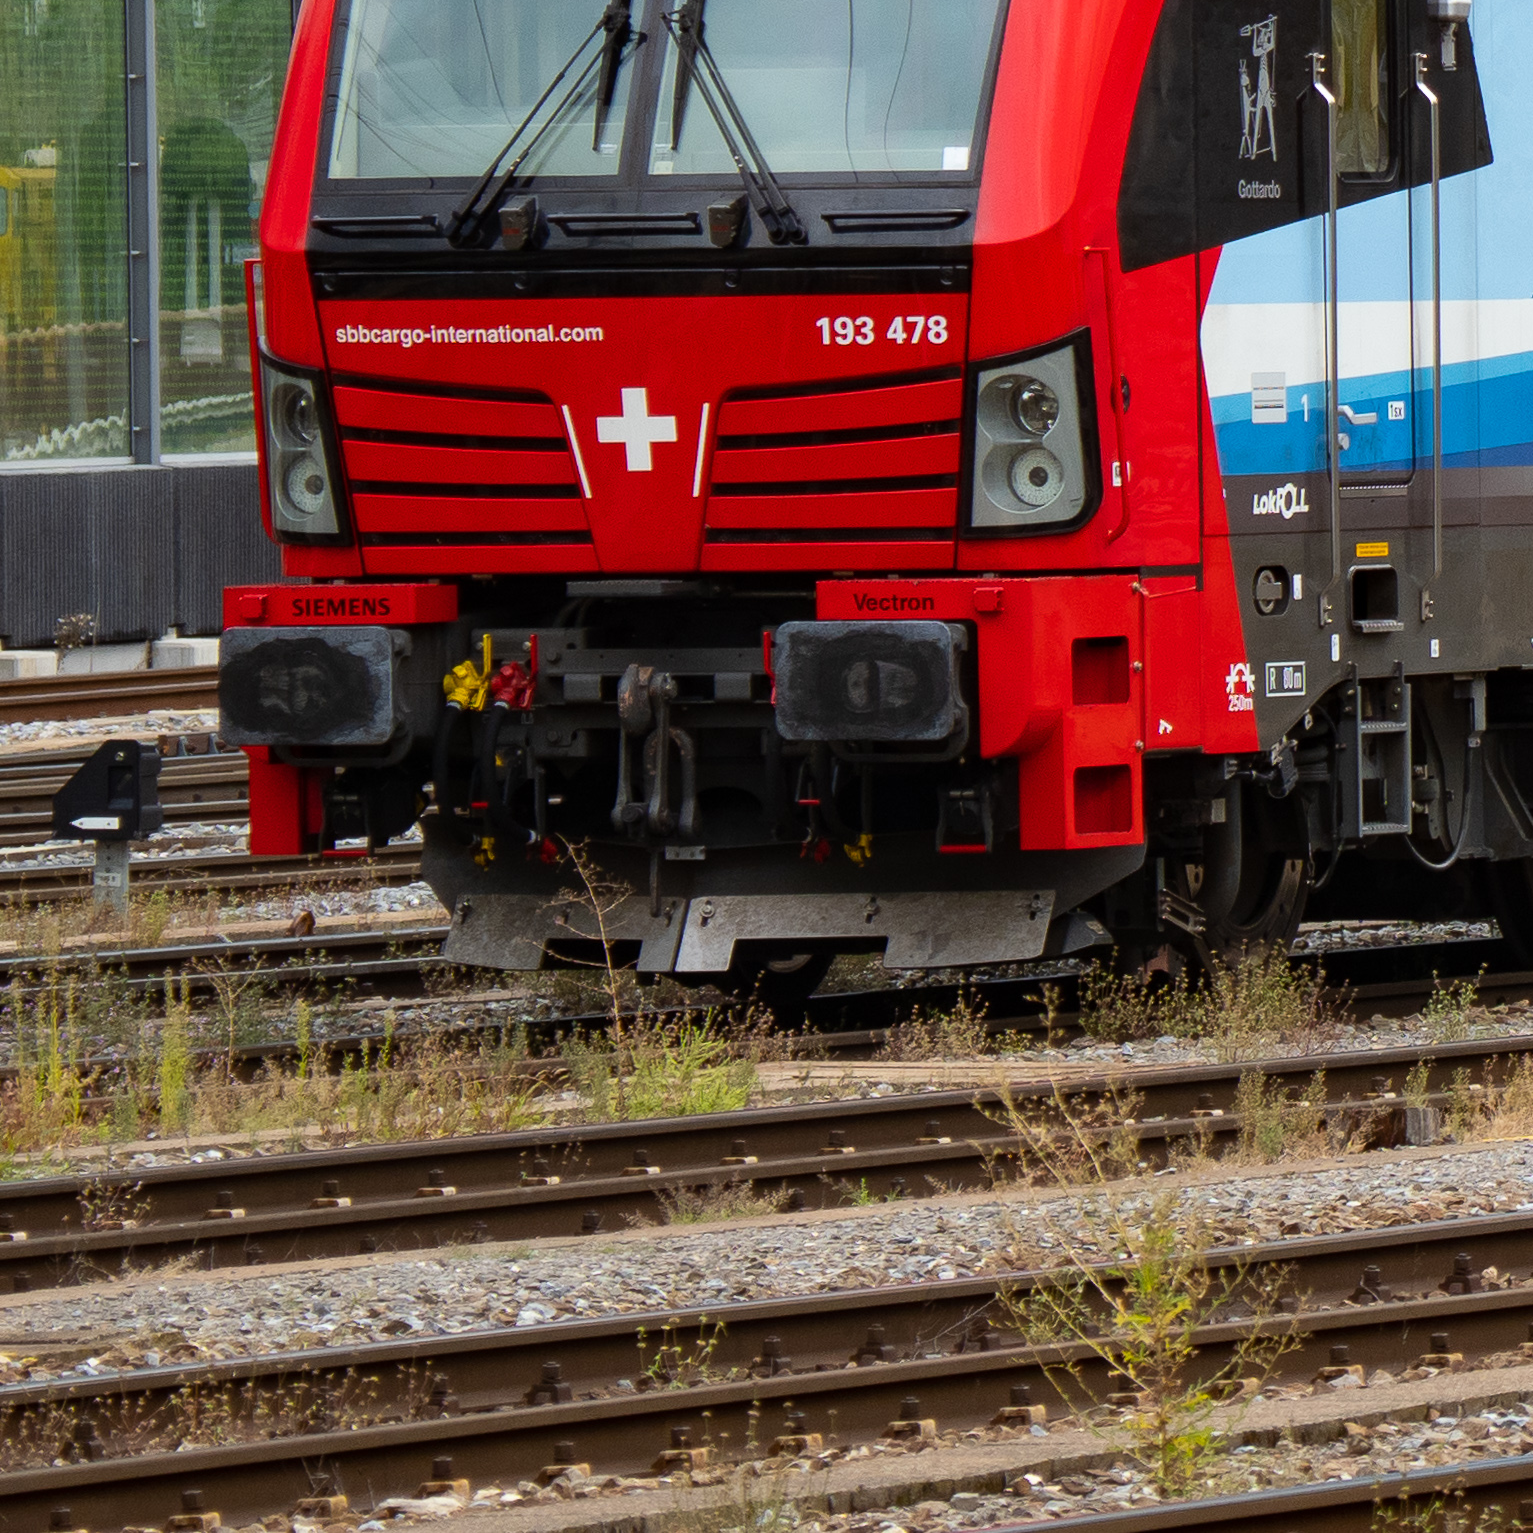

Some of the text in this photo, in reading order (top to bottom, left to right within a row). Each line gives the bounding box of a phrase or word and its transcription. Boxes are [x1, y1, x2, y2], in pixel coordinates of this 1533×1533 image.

[1238, 179, 1281, 198] Gottardo
[336, 324, 603, 348] sbbcargo-international.com
[815, 316, 949, 346] 193 478
[292, 595, 391, 619] SIEMENS
[853, 593, 935, 613] Vectron
[1269, 667, 1276, 690] R
[1228, 694, 1254, 712] 250m
